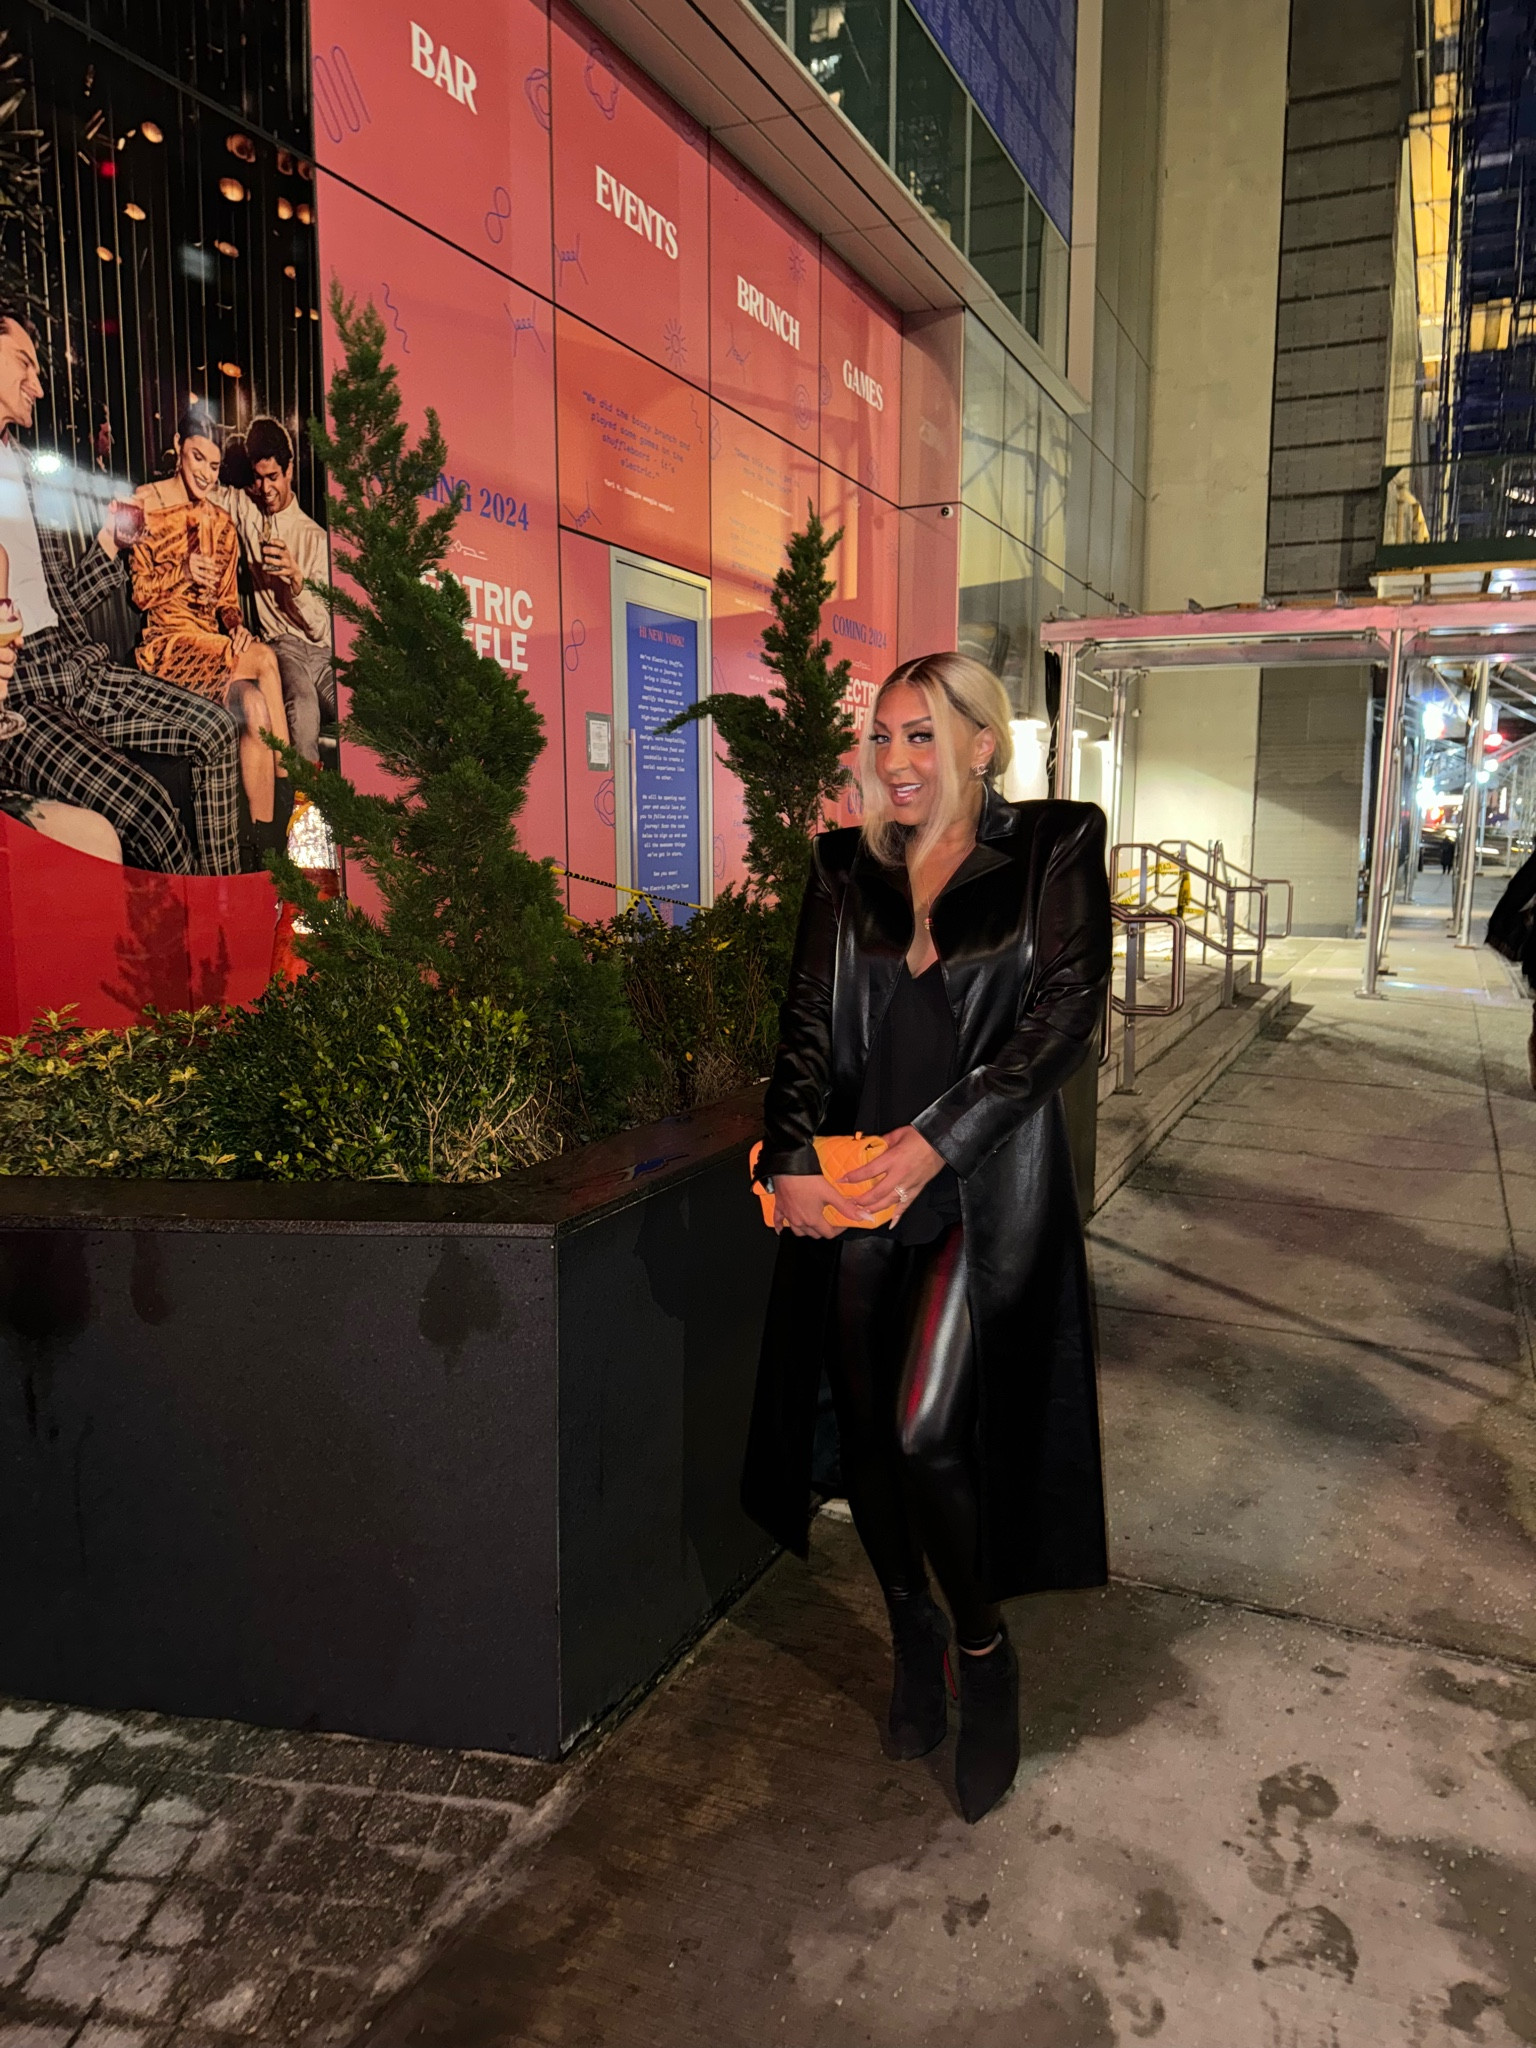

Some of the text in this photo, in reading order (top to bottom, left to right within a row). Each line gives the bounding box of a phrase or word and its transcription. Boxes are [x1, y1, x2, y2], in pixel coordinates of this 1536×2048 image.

[409, 20, 478, 115] BAR
[595, 164, 679, 260] EVENTS
[737, 275, 800, 350] BRUNCH
[843, 359, 884, 412] GAMES
[479, 488, 529, 531] 2024
[639, 626, 647, 638] HI
[648, 628, 664, 642] NEW
[832, 614, 887, 650] COMING 2024
